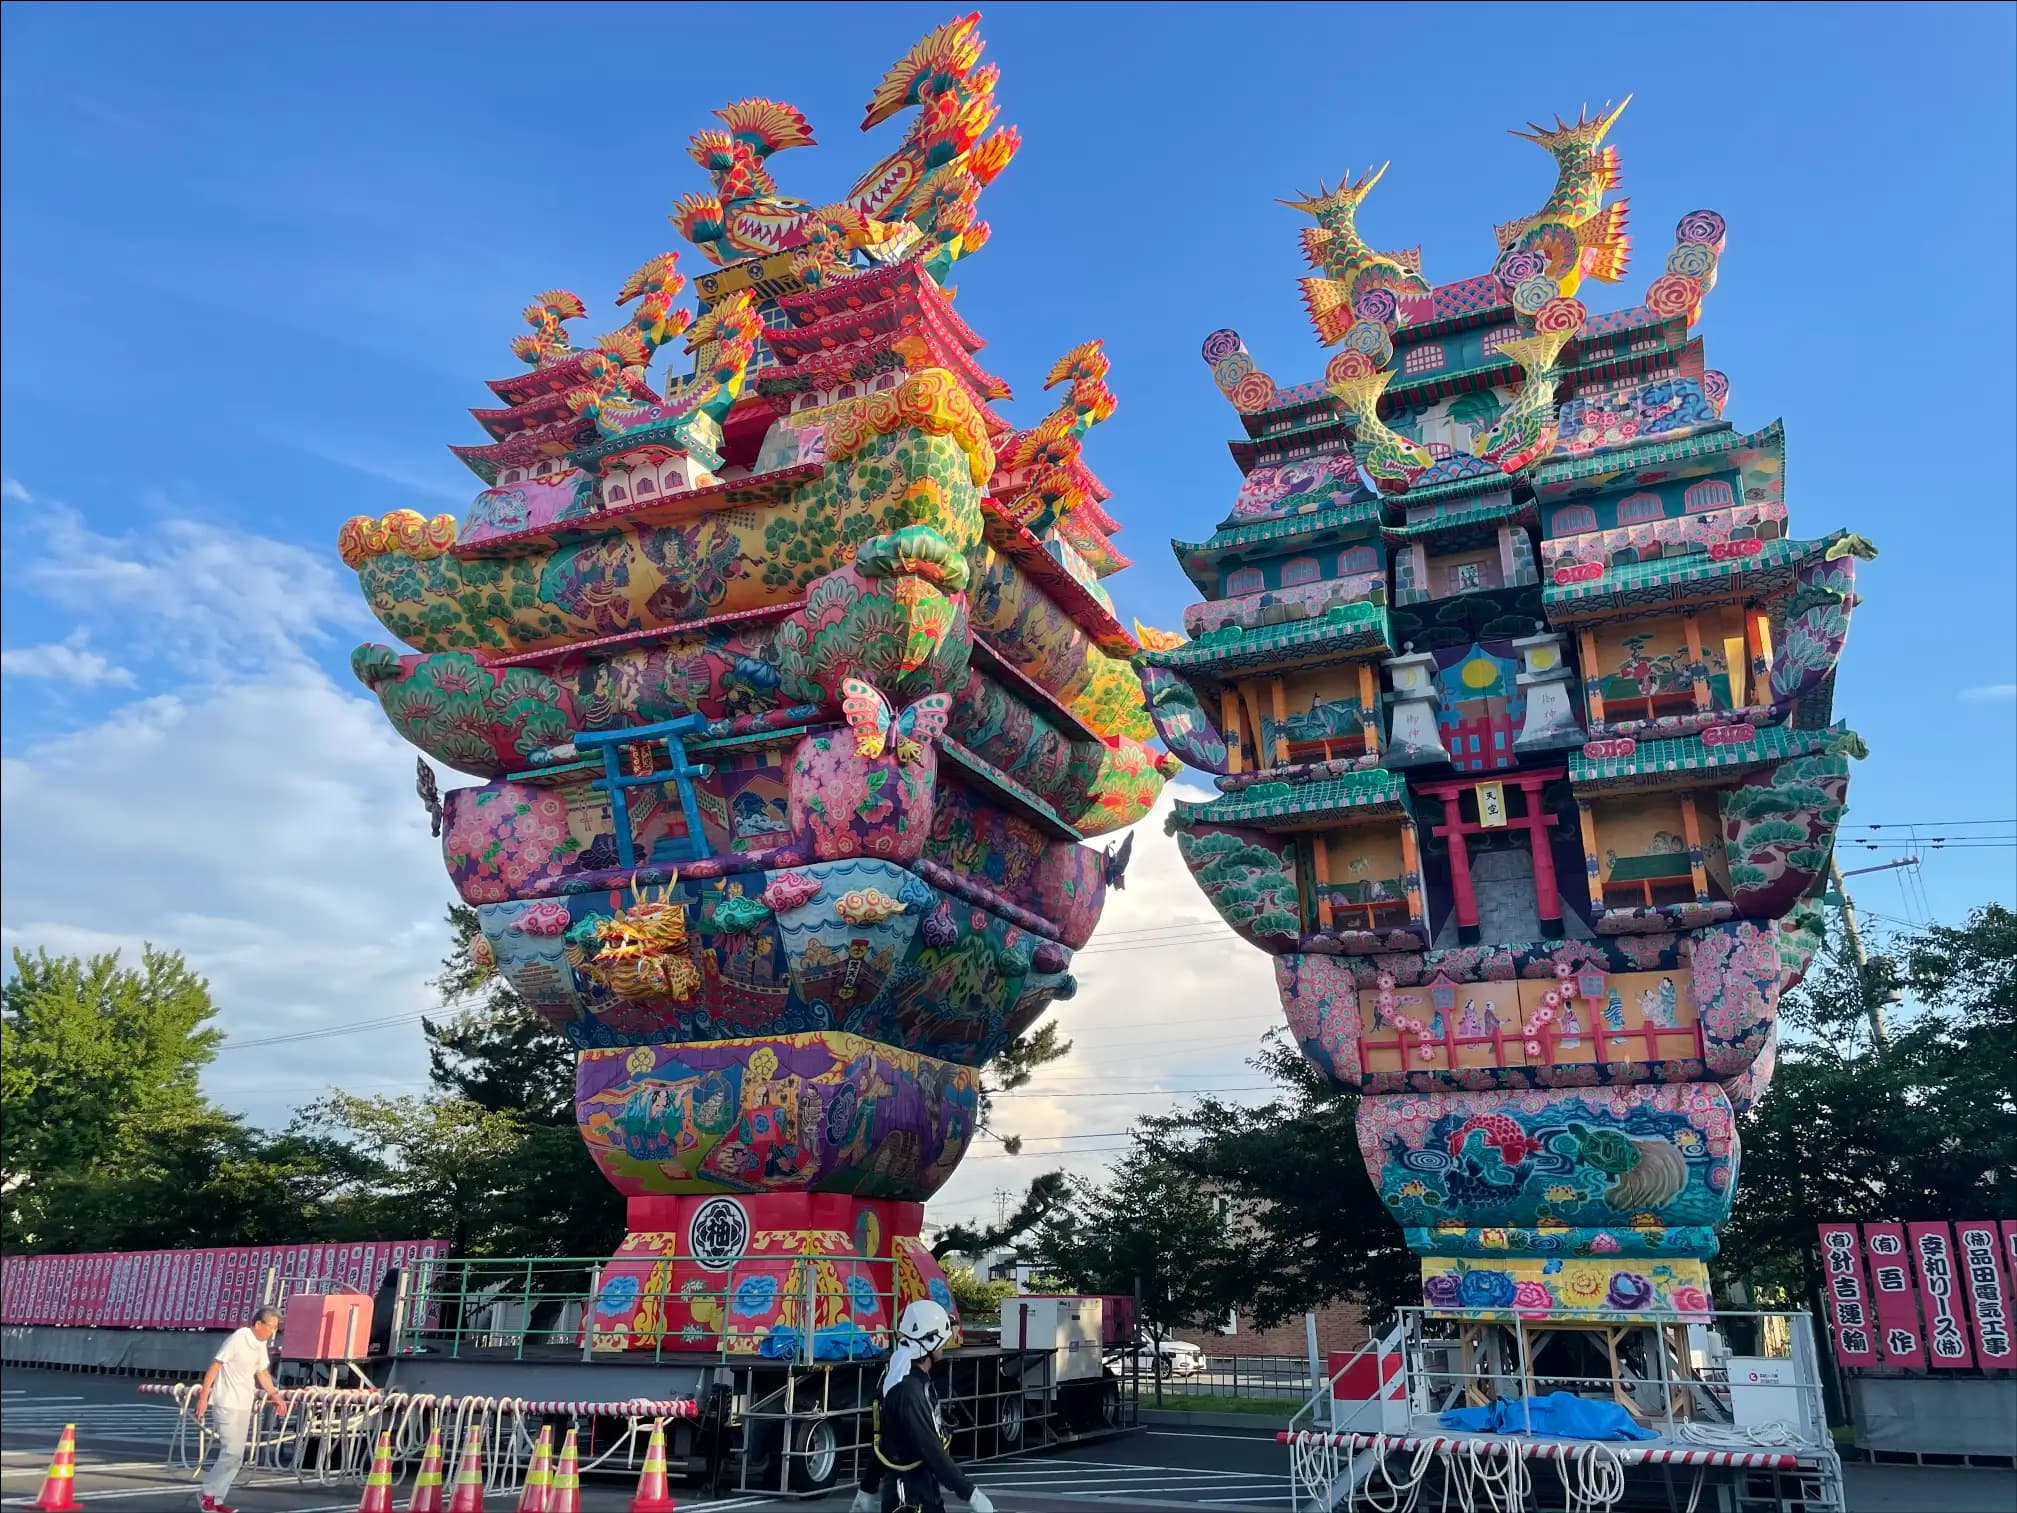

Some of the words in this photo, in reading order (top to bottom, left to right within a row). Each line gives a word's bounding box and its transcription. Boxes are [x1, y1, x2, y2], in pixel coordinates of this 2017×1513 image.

[1485, 791, 1499, 816] 天空
[1920, 1235, 1963, 1356] 幸和リース(株)
[1963, 1231, 2009, 1355] (株)品田電気工事
